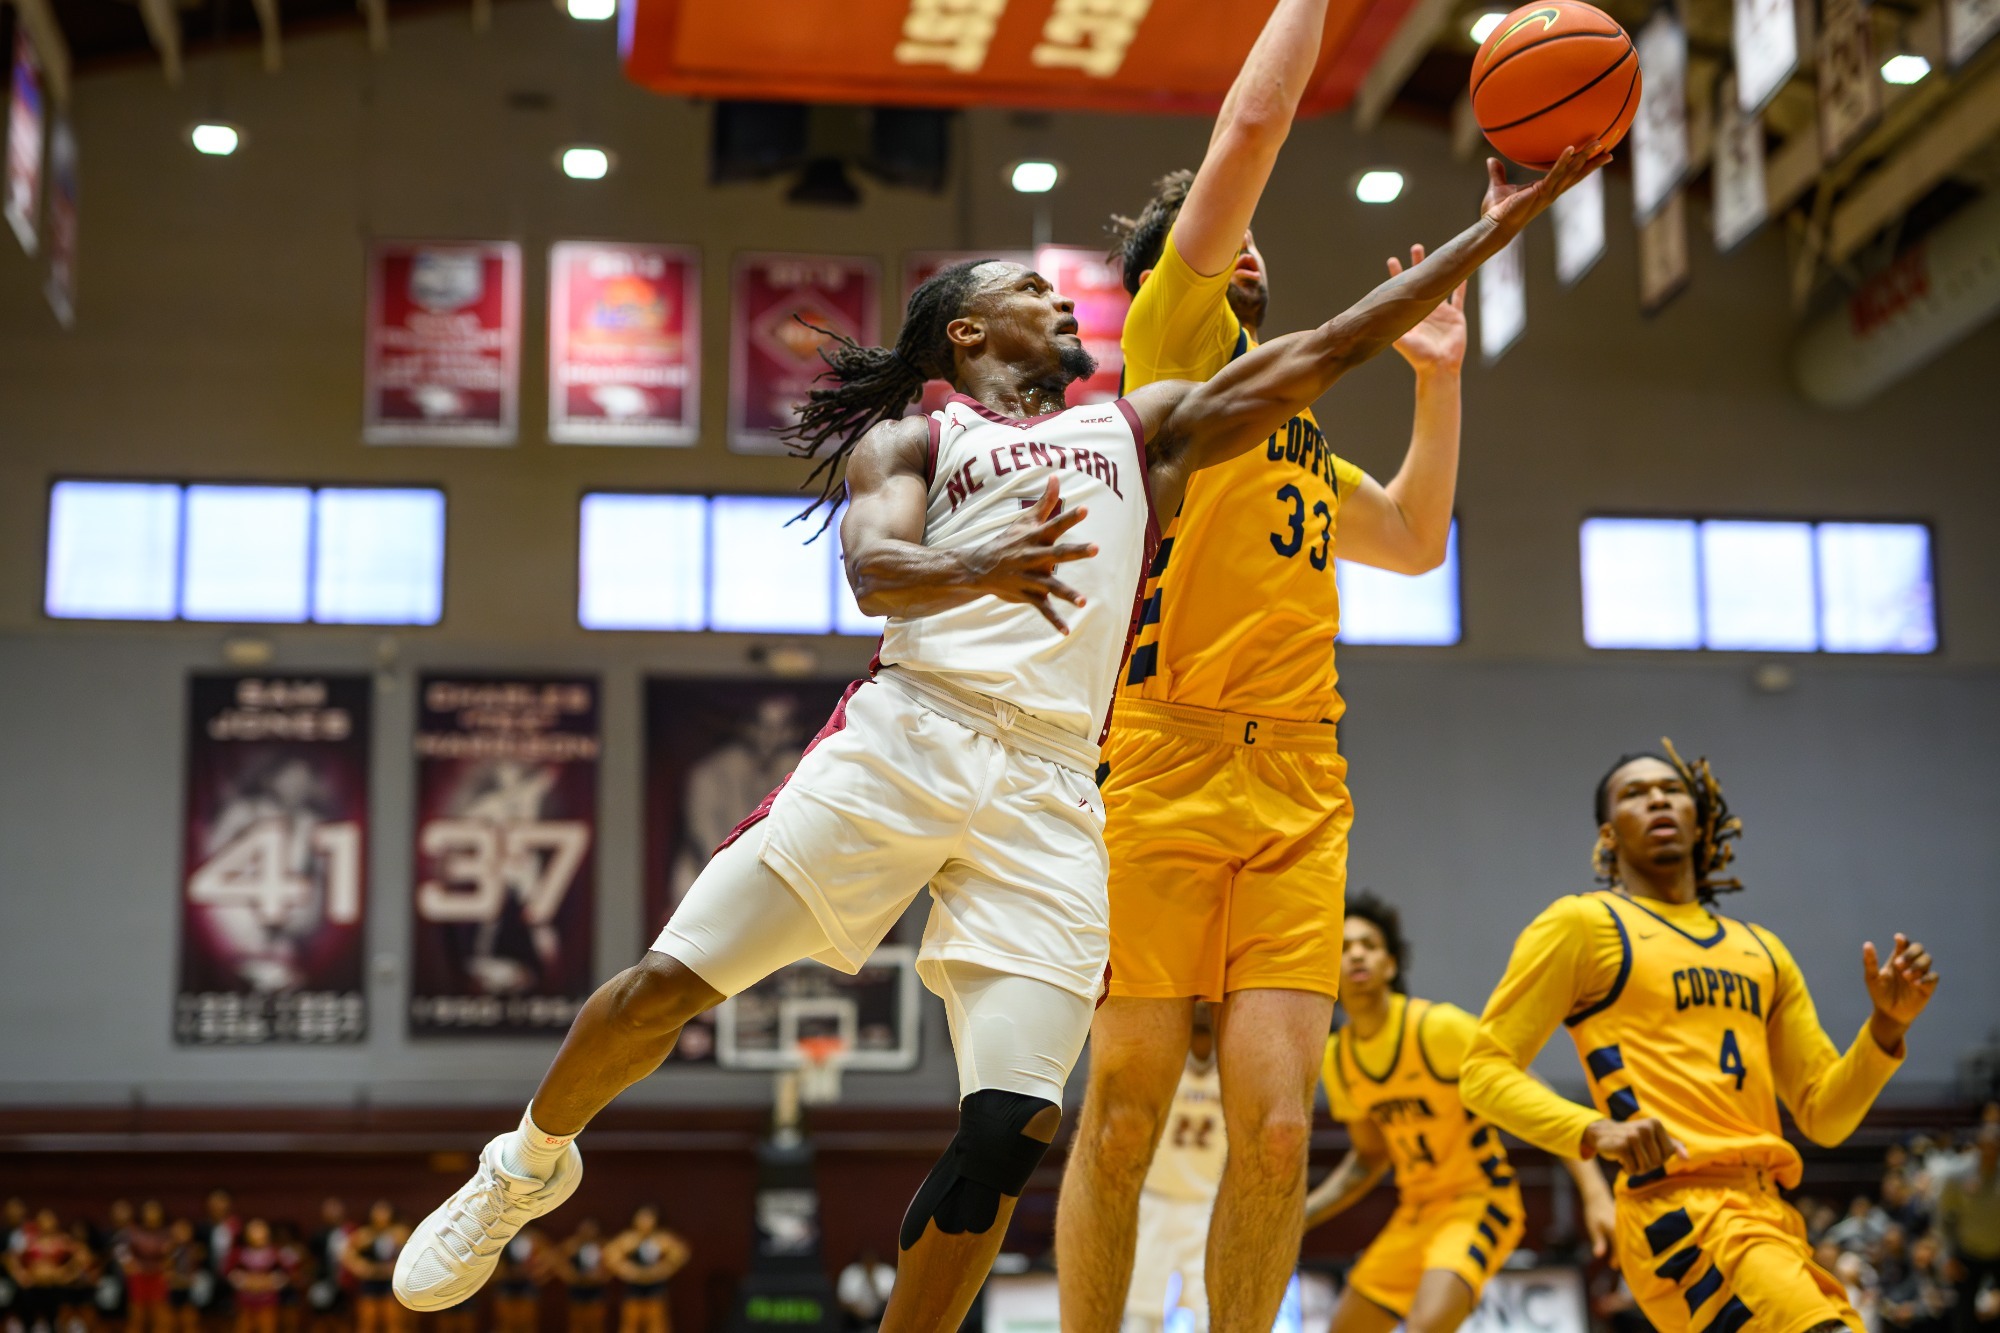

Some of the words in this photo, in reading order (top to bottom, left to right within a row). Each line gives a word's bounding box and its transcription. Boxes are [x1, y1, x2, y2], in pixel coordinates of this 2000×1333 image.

[1080, 416, 1113, 424] MEAC
[946, 456, 985, 514] NC
[990, 441, 1124, 502] CENTRAL
[1270, 483, 1332, 572] 33
[1244, 721, 1258, 744] C
[188, 818, 363, 926] 41
[418, 819, 592, 924] 37
[1673, 966, 1762, 1020] COPPIN
[1719, 1029, 1746, 1091] 4
[1172, 1114, 1215, 1150] 22
